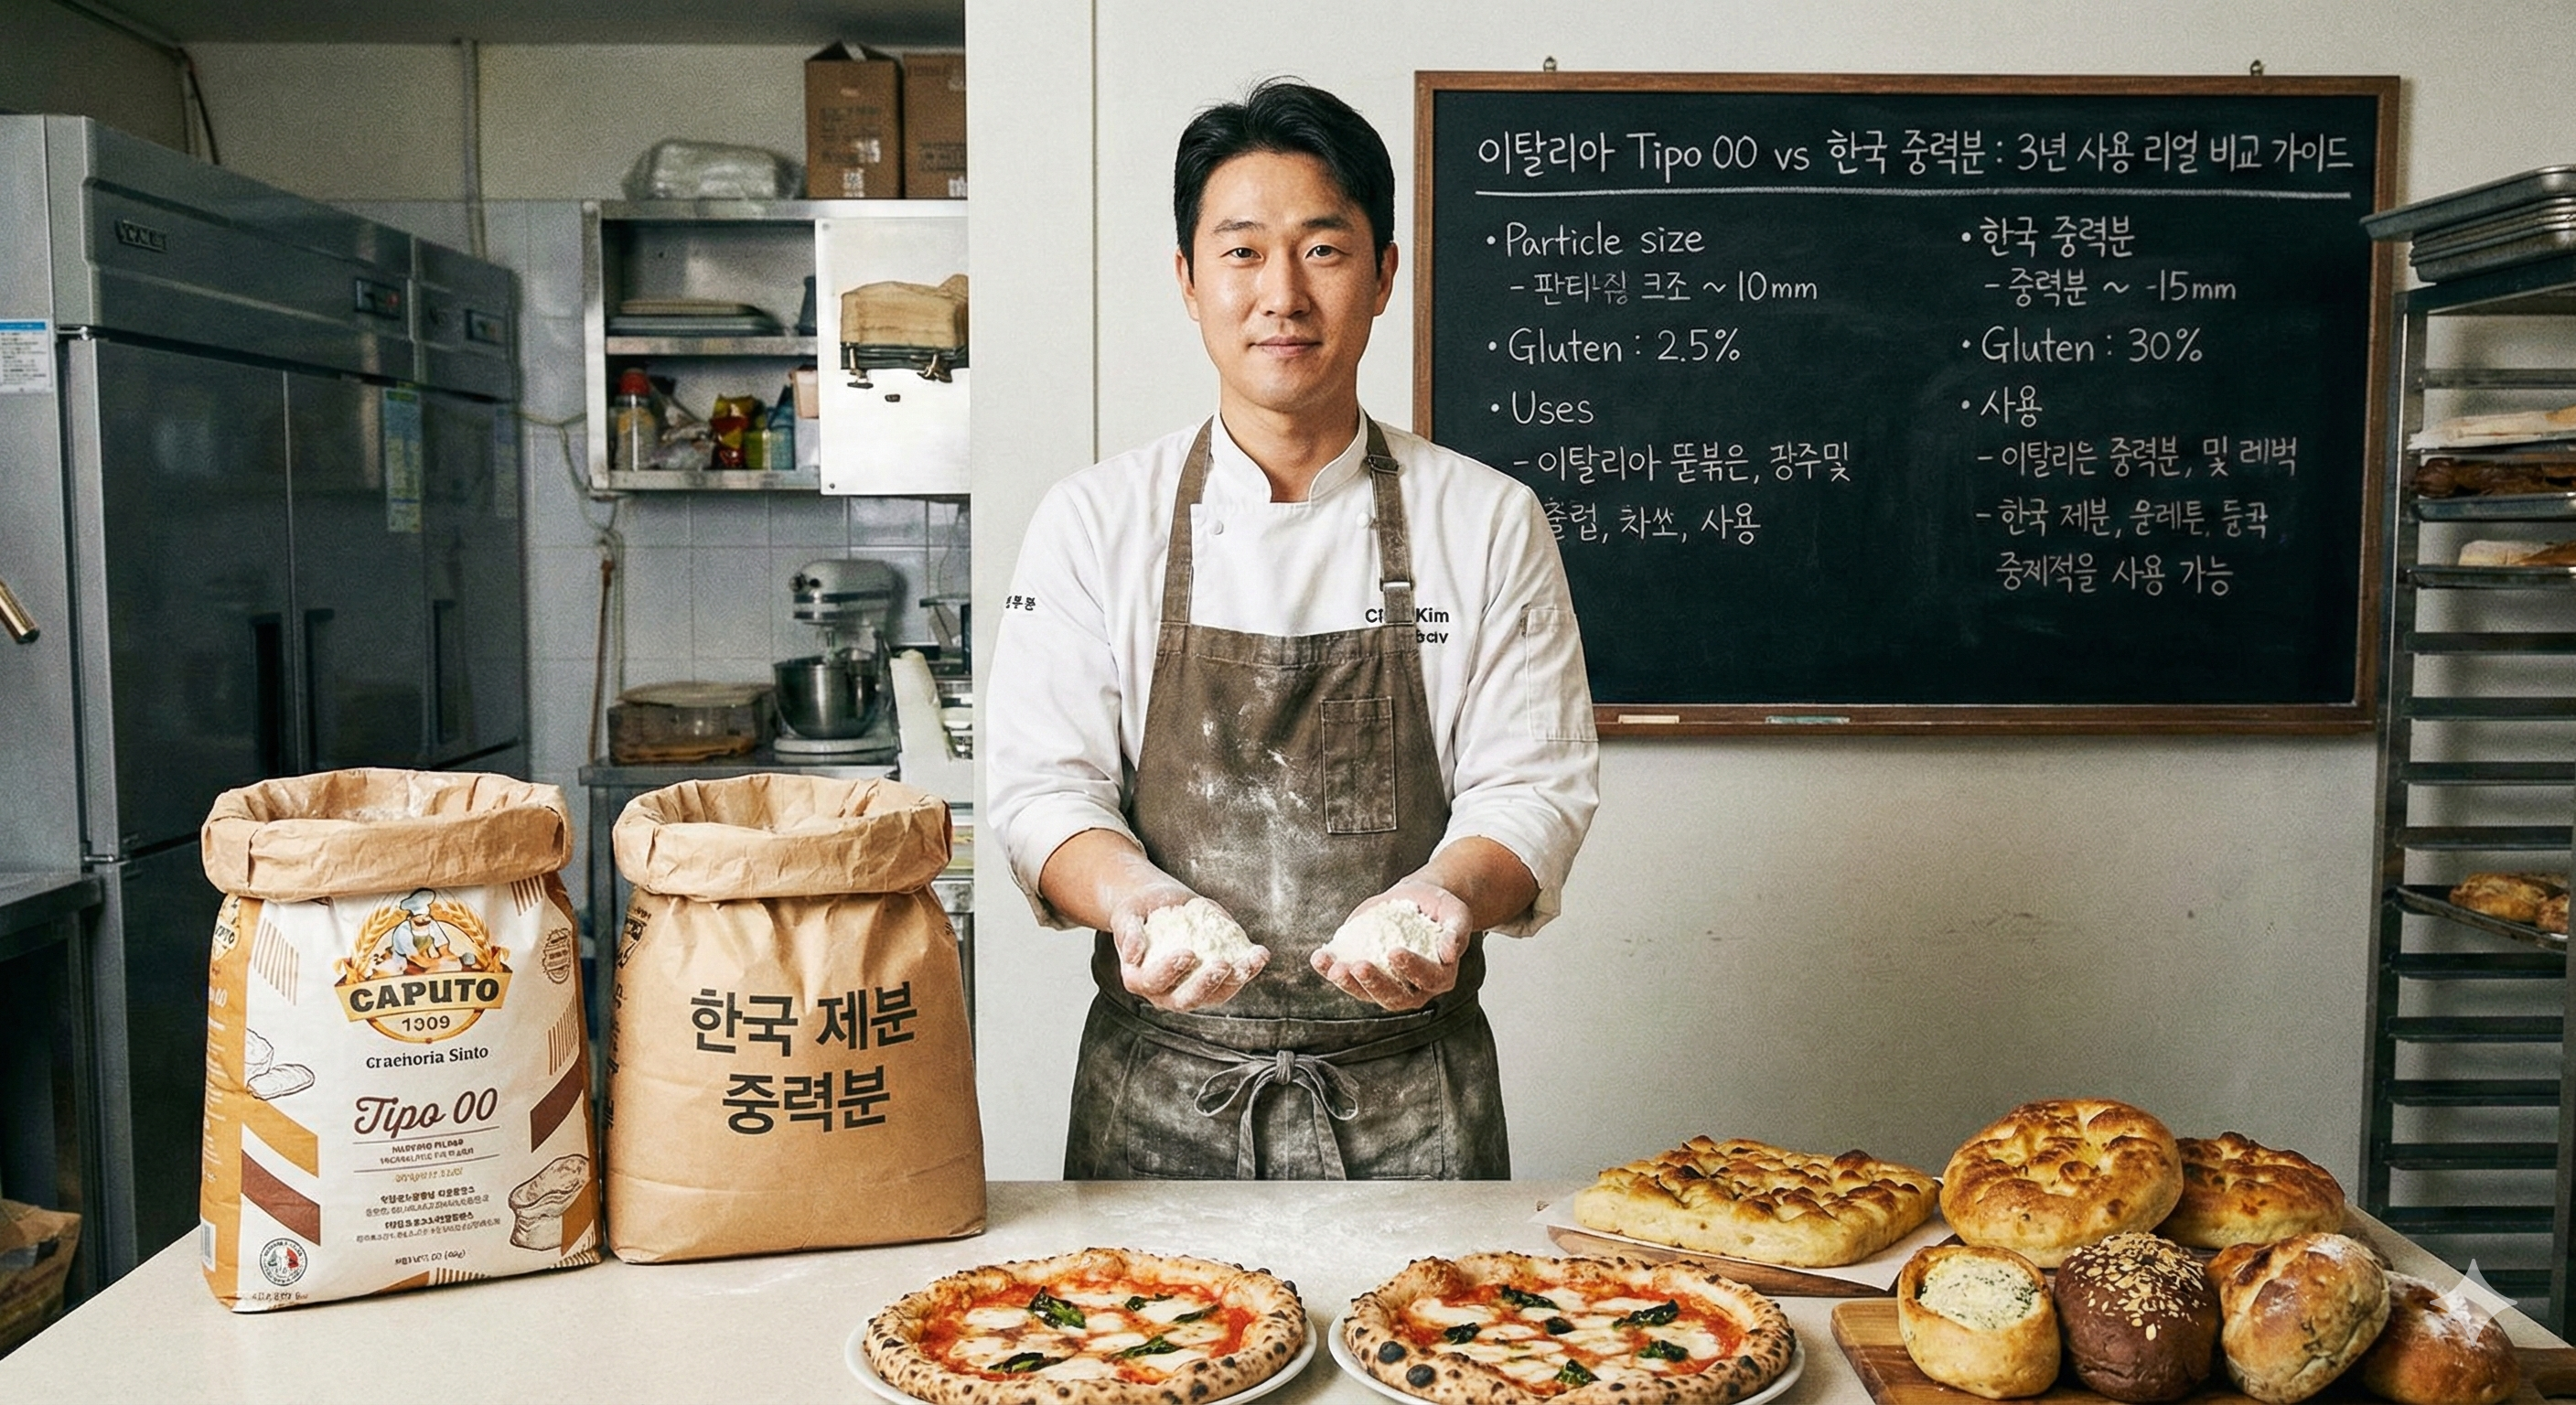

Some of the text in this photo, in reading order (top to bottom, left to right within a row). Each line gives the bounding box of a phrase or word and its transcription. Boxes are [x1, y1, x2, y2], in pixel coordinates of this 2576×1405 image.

[1478, 130, 1615, 177] 이탈리아
[1626, 132, 1702, 184] Tipo
[1712, 134, 1758, 169] 00
[1774, 146, 1810, 171] vs
[1827, 129, 1888, 175] 한국
[2017, 132, 2066, 172] 3년
[2077, 131, 2135, 174] 사용
[2144, 130, 2198, 175] 리얼
[2210, 134, 2262, 172] 비교
[2271, 132, 2354, 173] 가이드
[1507, 220, 1705, 257] Particle size
[1979, 215, 2135, 258] 한국 중력분
[2008, 267, 2088, 307] 중력분
[1658, 327, 1741, 362] 2.5%
[2129, 327, 2203, 362] 30%
[1511, 390, 1594, 424] Uses
[1980, 384, 2043, 428] 사용
[1538, 444, 1662, 485] 이탈리아
[2203, 435, 2228, 477] 및
[1701, 502, 1761, 545] 사용
[1998, 497, 2049, 537] 한국
[2111, 554, 2166, 596] 사용
[2179, 554, 2234, 596] 가능
[1415, 606, 1450, 623] Kim
[349, 978, 500, 1013] CAPUTO
[691, 981, 918, 1057] 한국 제분
[449, 1046, 488, 1062] Sinto
[354, 1088, 498, 1140] Tipo 00
[723, 1064, 891, 1135] 중력분
